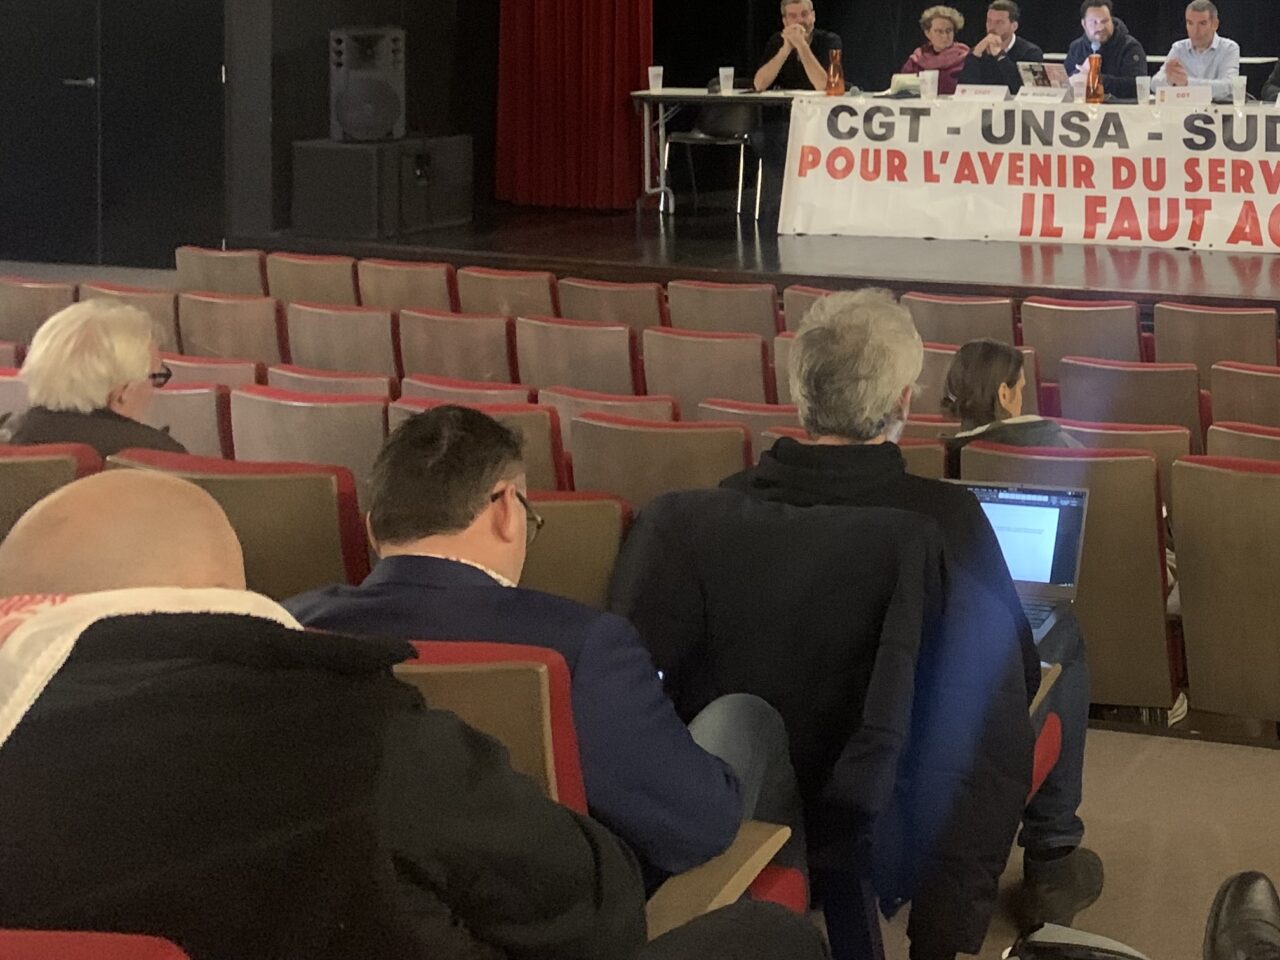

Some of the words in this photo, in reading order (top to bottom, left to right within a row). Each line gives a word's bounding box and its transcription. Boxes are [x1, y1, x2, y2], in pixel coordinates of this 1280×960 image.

[826, 104, 931, 142] CGT
[946, 126, 961, 135] -
[981, 109, 1129, 149] UNSA
[1148, 132, 1163, 141] -
[797, 144, 908, 182] POUR
[922, 149, 1096, 190] L'AVENIR
[1111, 155, 1167, 193] DU
[1018, 191, 1064, 239] IL
[1082, 194, 1213, 243] FAUT
